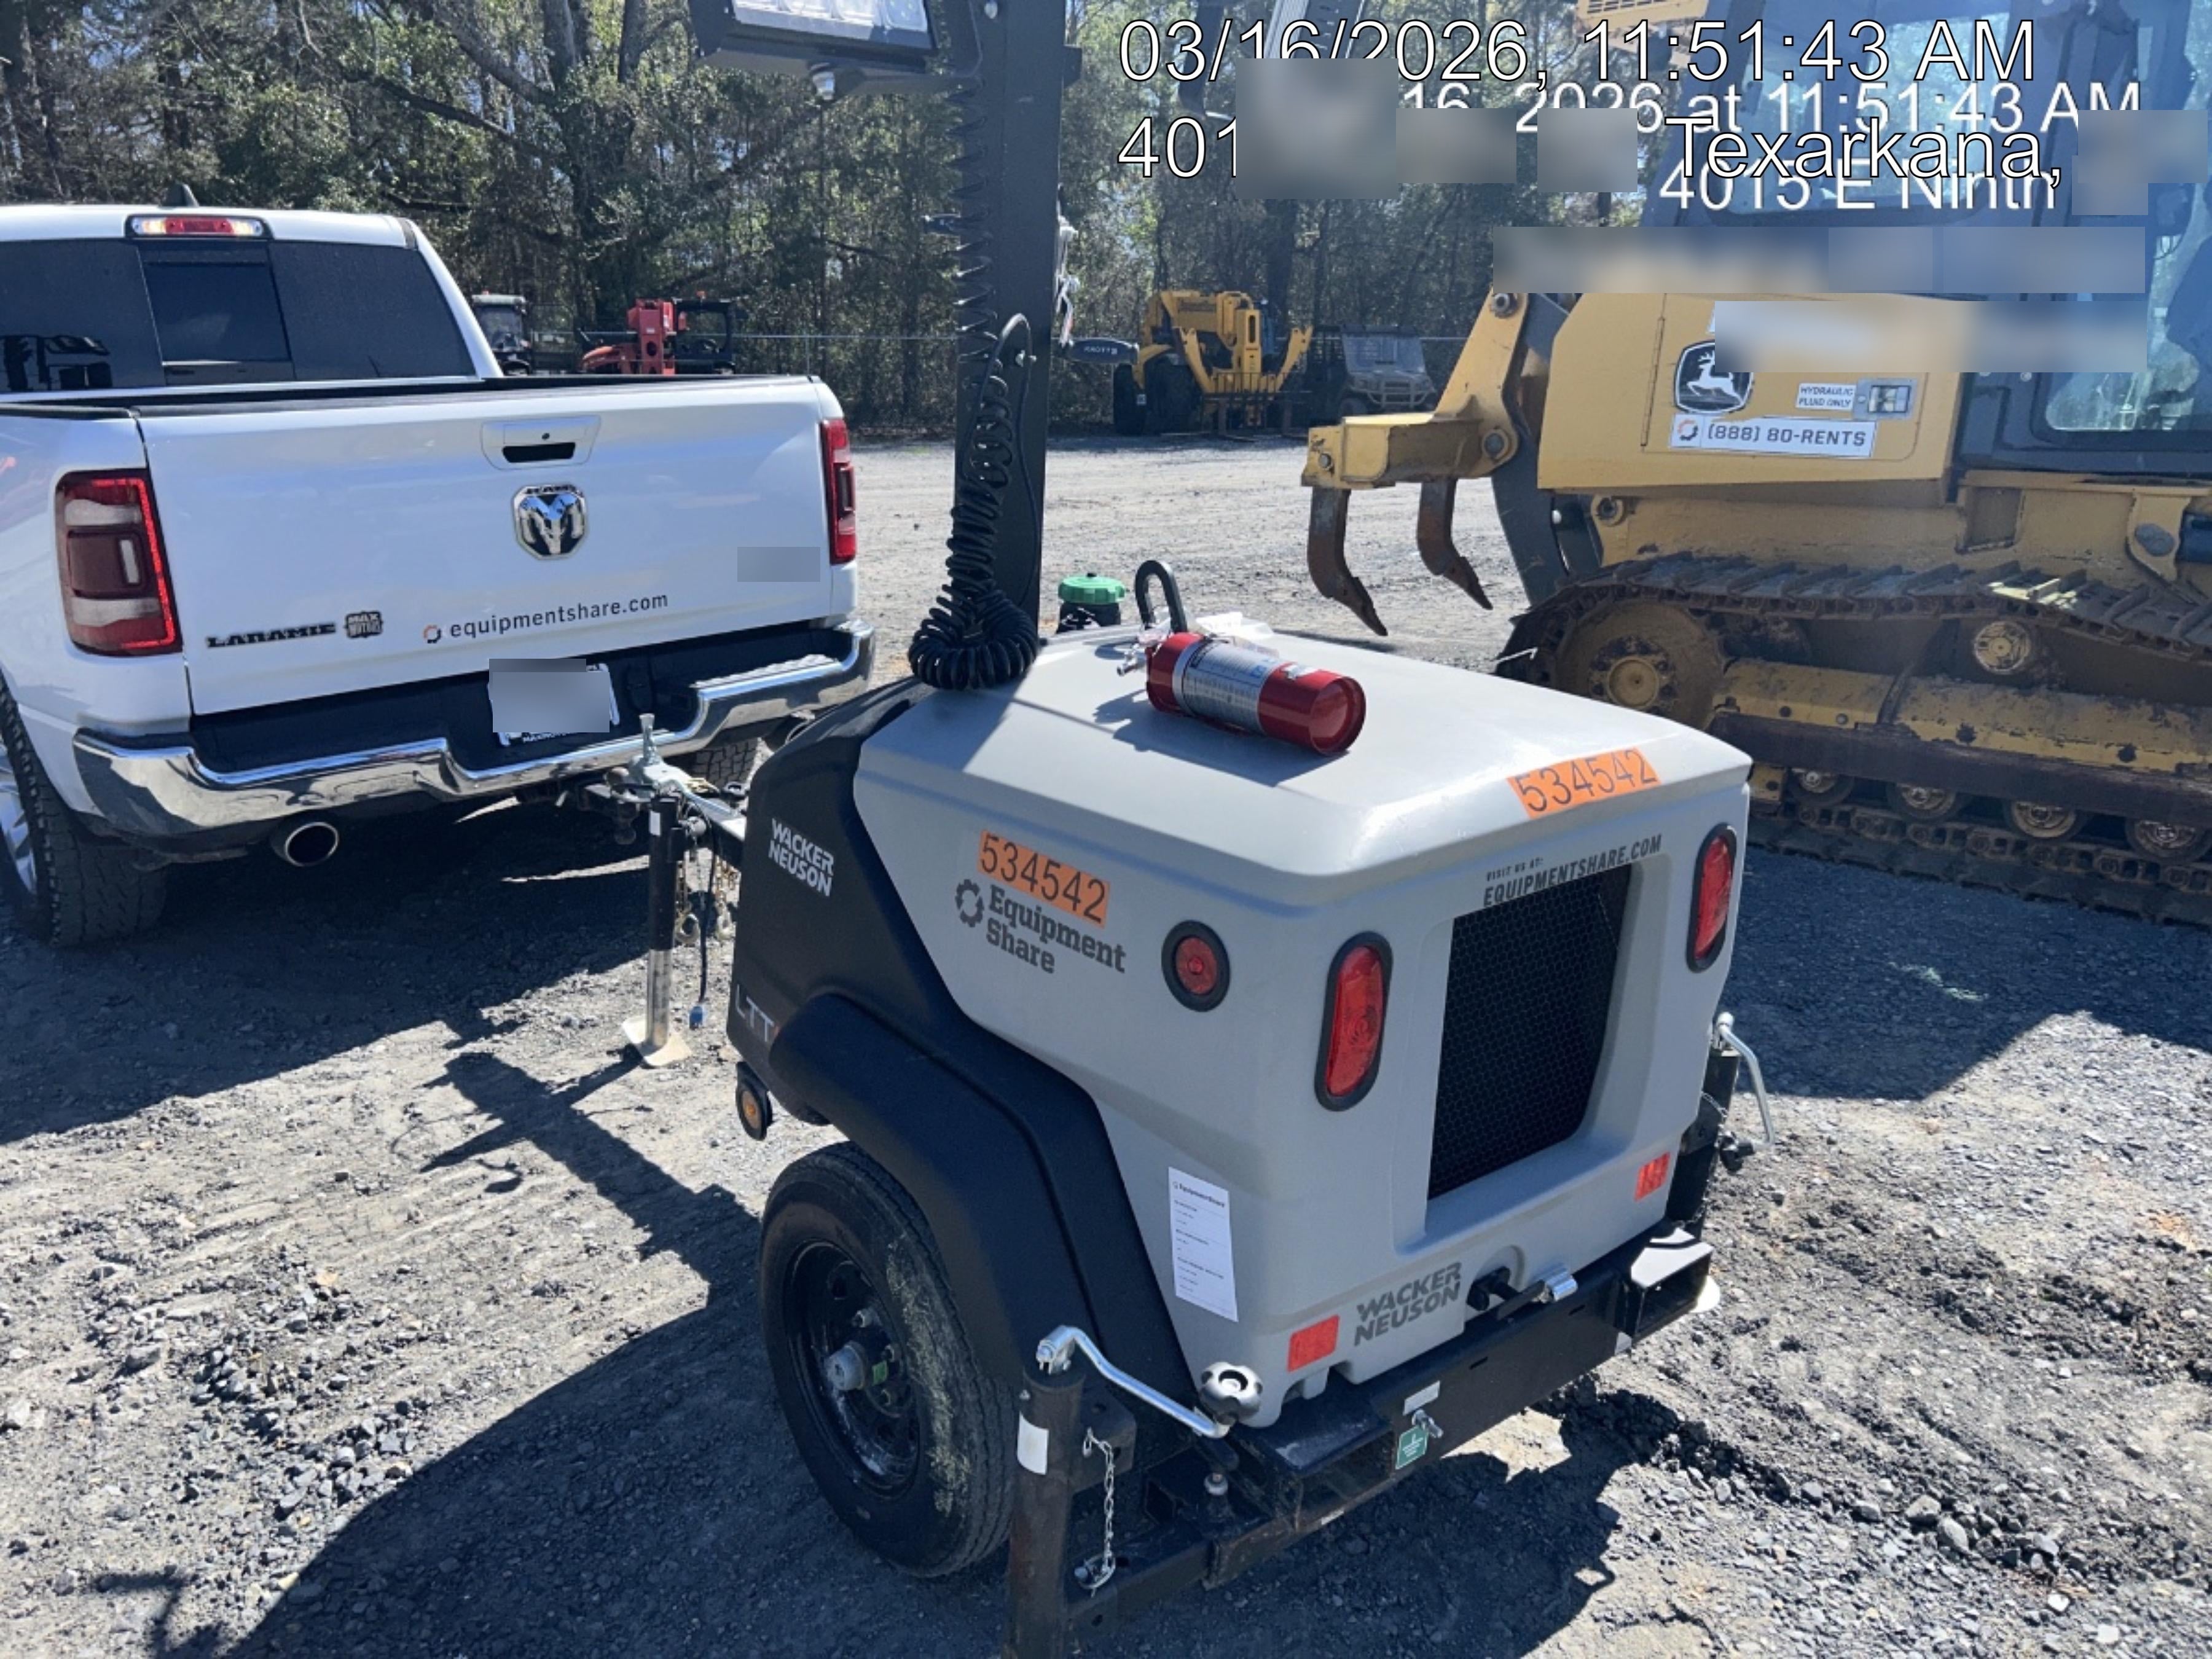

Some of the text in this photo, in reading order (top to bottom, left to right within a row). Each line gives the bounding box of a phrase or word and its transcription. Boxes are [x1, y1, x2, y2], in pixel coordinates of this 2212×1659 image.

[1708, 423, 1866, 447] (888) 80-RENTS
[206, 622, 336, 648] LARAMIE
[450, 594, 668, 638] equipmentshare.com
[1514, 749, 1658, 812] 534542
[768, 840, 832, 896] NEUSON
[772, 818, 834, 876] WACKER
[1483, 834, 1662, 908] EQUIPMENTSHARE.COM
[981, 833, 1105, 924] 534542
[986, 917, 1055, 974] Share
[989, 884, 1126, 974] Equipment
[1354, 1281, 1461, 1346] NEUSON
[1356, 1262, 1461, 1322] WACKER
